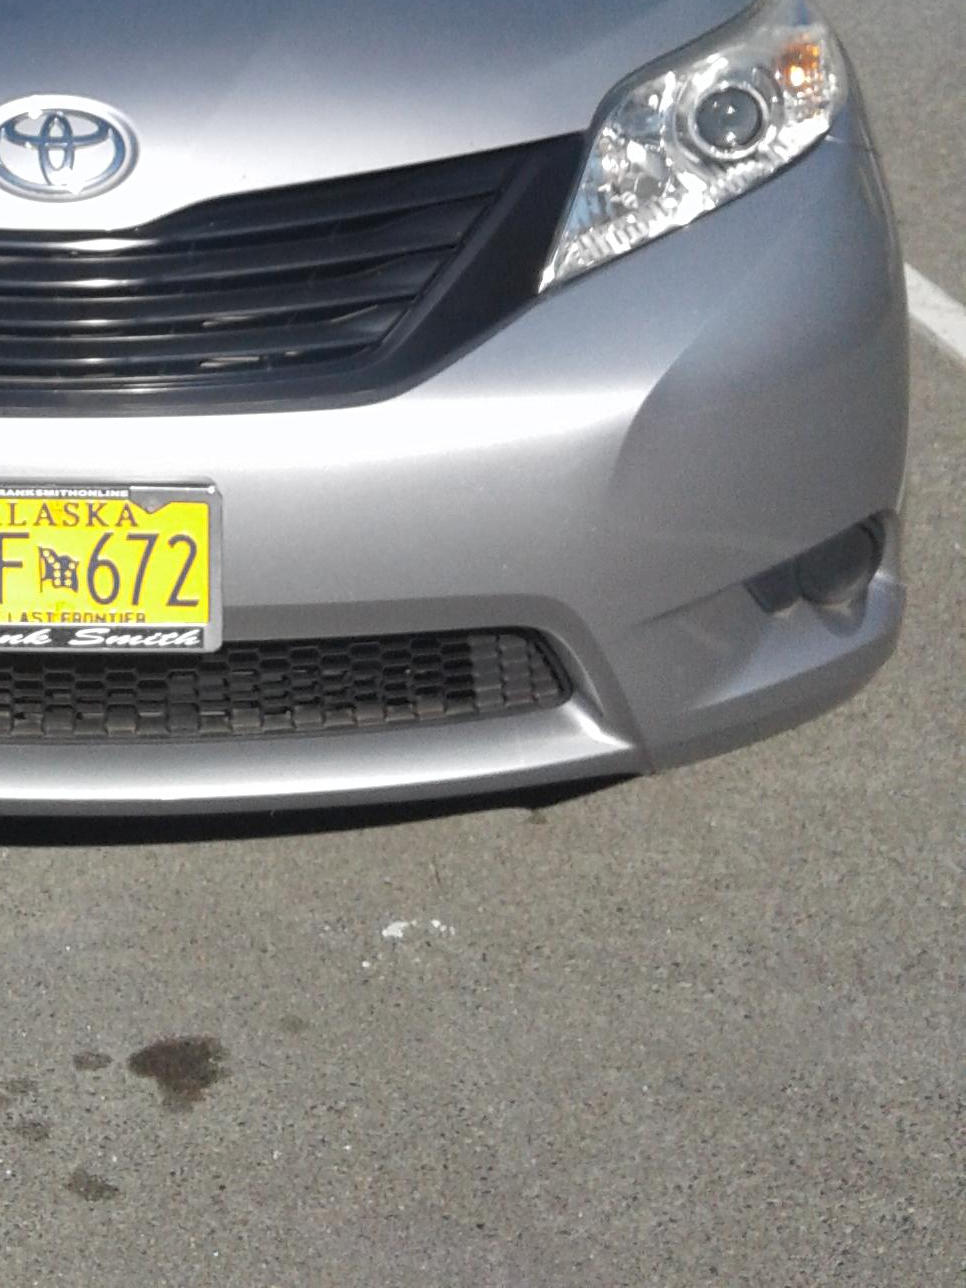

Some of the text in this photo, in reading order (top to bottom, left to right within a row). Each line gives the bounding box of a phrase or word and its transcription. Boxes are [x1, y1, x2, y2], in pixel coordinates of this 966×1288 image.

[87, 531, 200, 607] 672
[8, 611, 53, 623] LAST
[60, 611, 146, 624] FRONTIER
[67, 627, 201, 647] Smith
